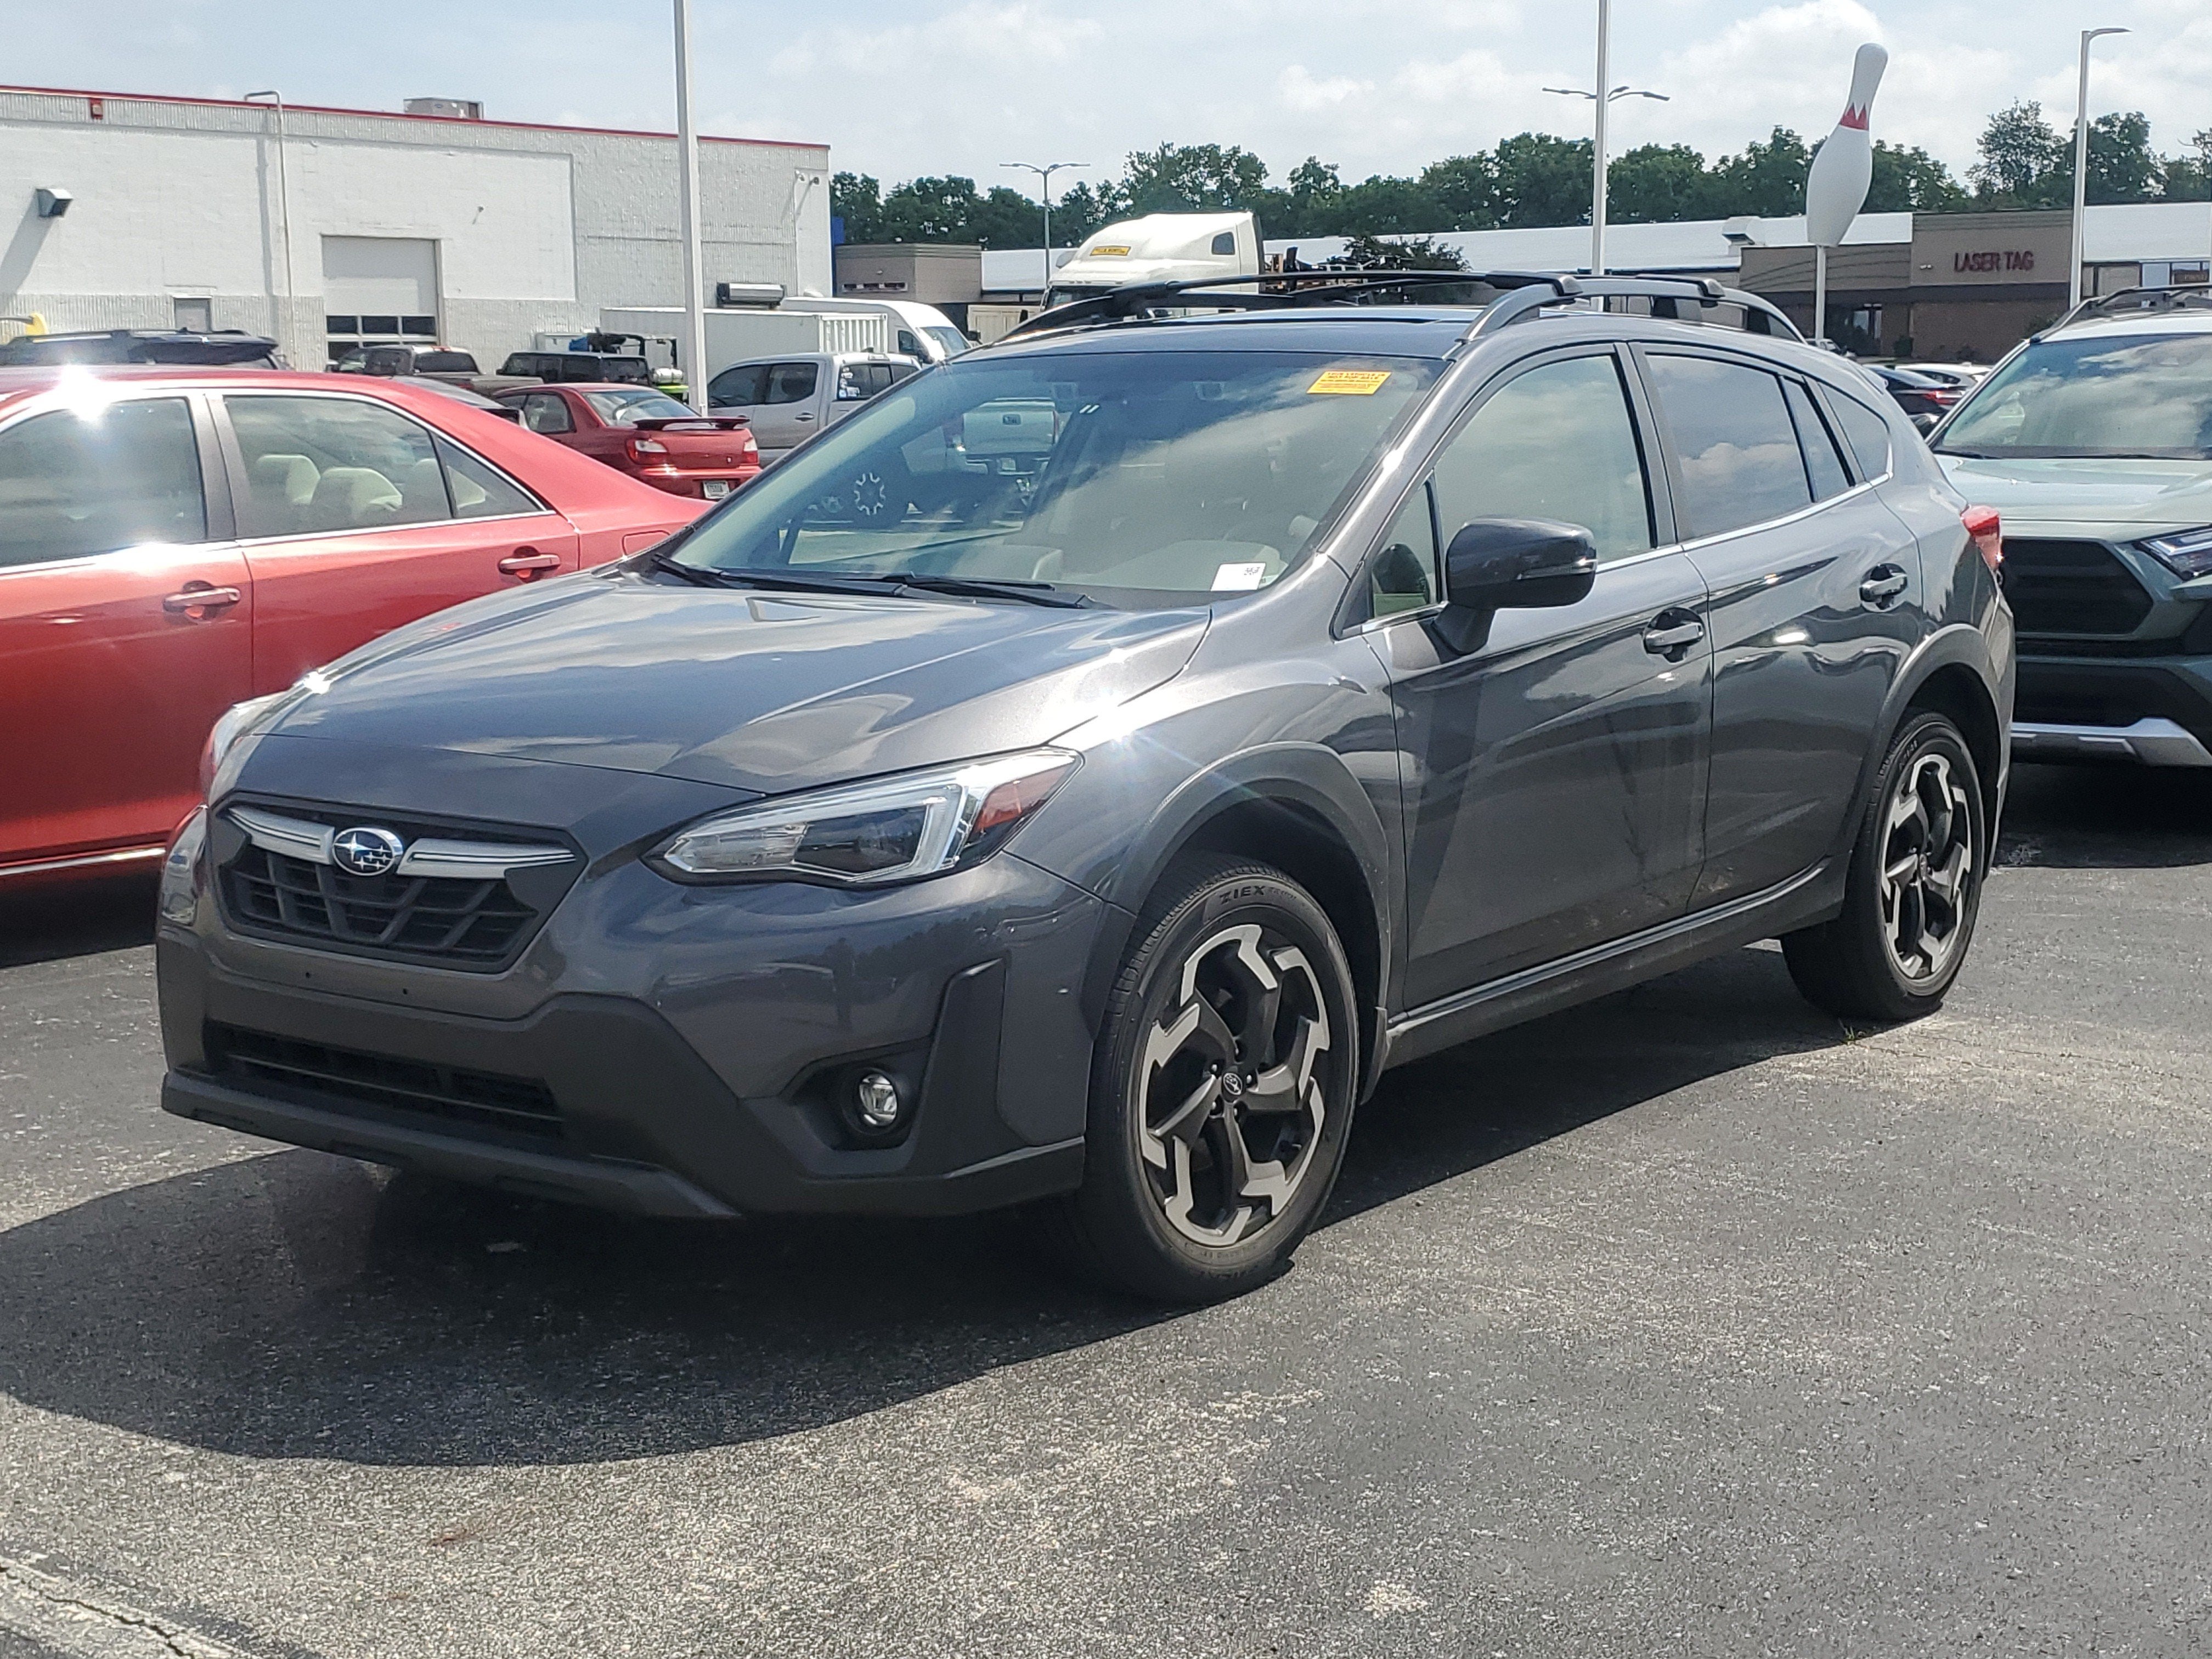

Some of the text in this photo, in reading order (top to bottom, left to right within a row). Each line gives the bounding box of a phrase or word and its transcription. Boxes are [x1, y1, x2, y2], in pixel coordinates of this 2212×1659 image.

[1954, 251, 2034, 272] LASER TAG
[1219, 885, 1266, 905] ZIEX
